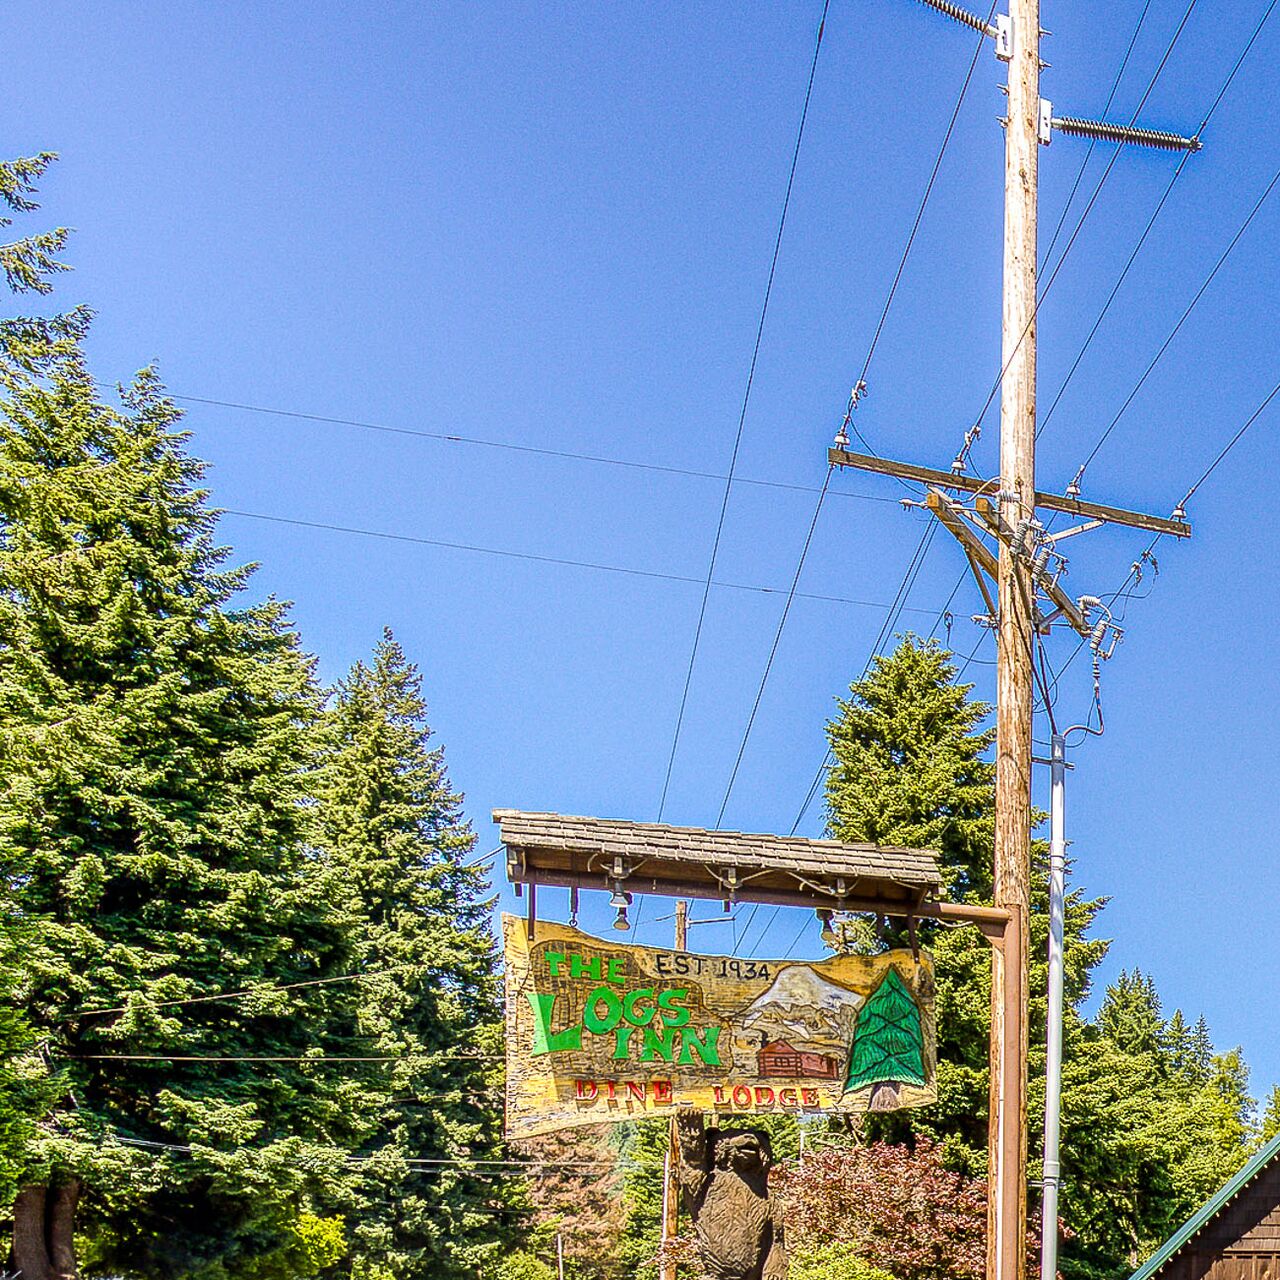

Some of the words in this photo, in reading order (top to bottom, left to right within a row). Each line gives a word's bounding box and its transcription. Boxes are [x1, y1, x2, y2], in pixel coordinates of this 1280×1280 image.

[544, 951, 625, 984] THE
[720, 959, 770, 981] 1934
[526, 986, 691, 1057] LOGS
[611, 1026, 722, 1067] INN
[575, 1079, 673, 1102] DINE
[711, 1083, 820, 1106] LODGE
